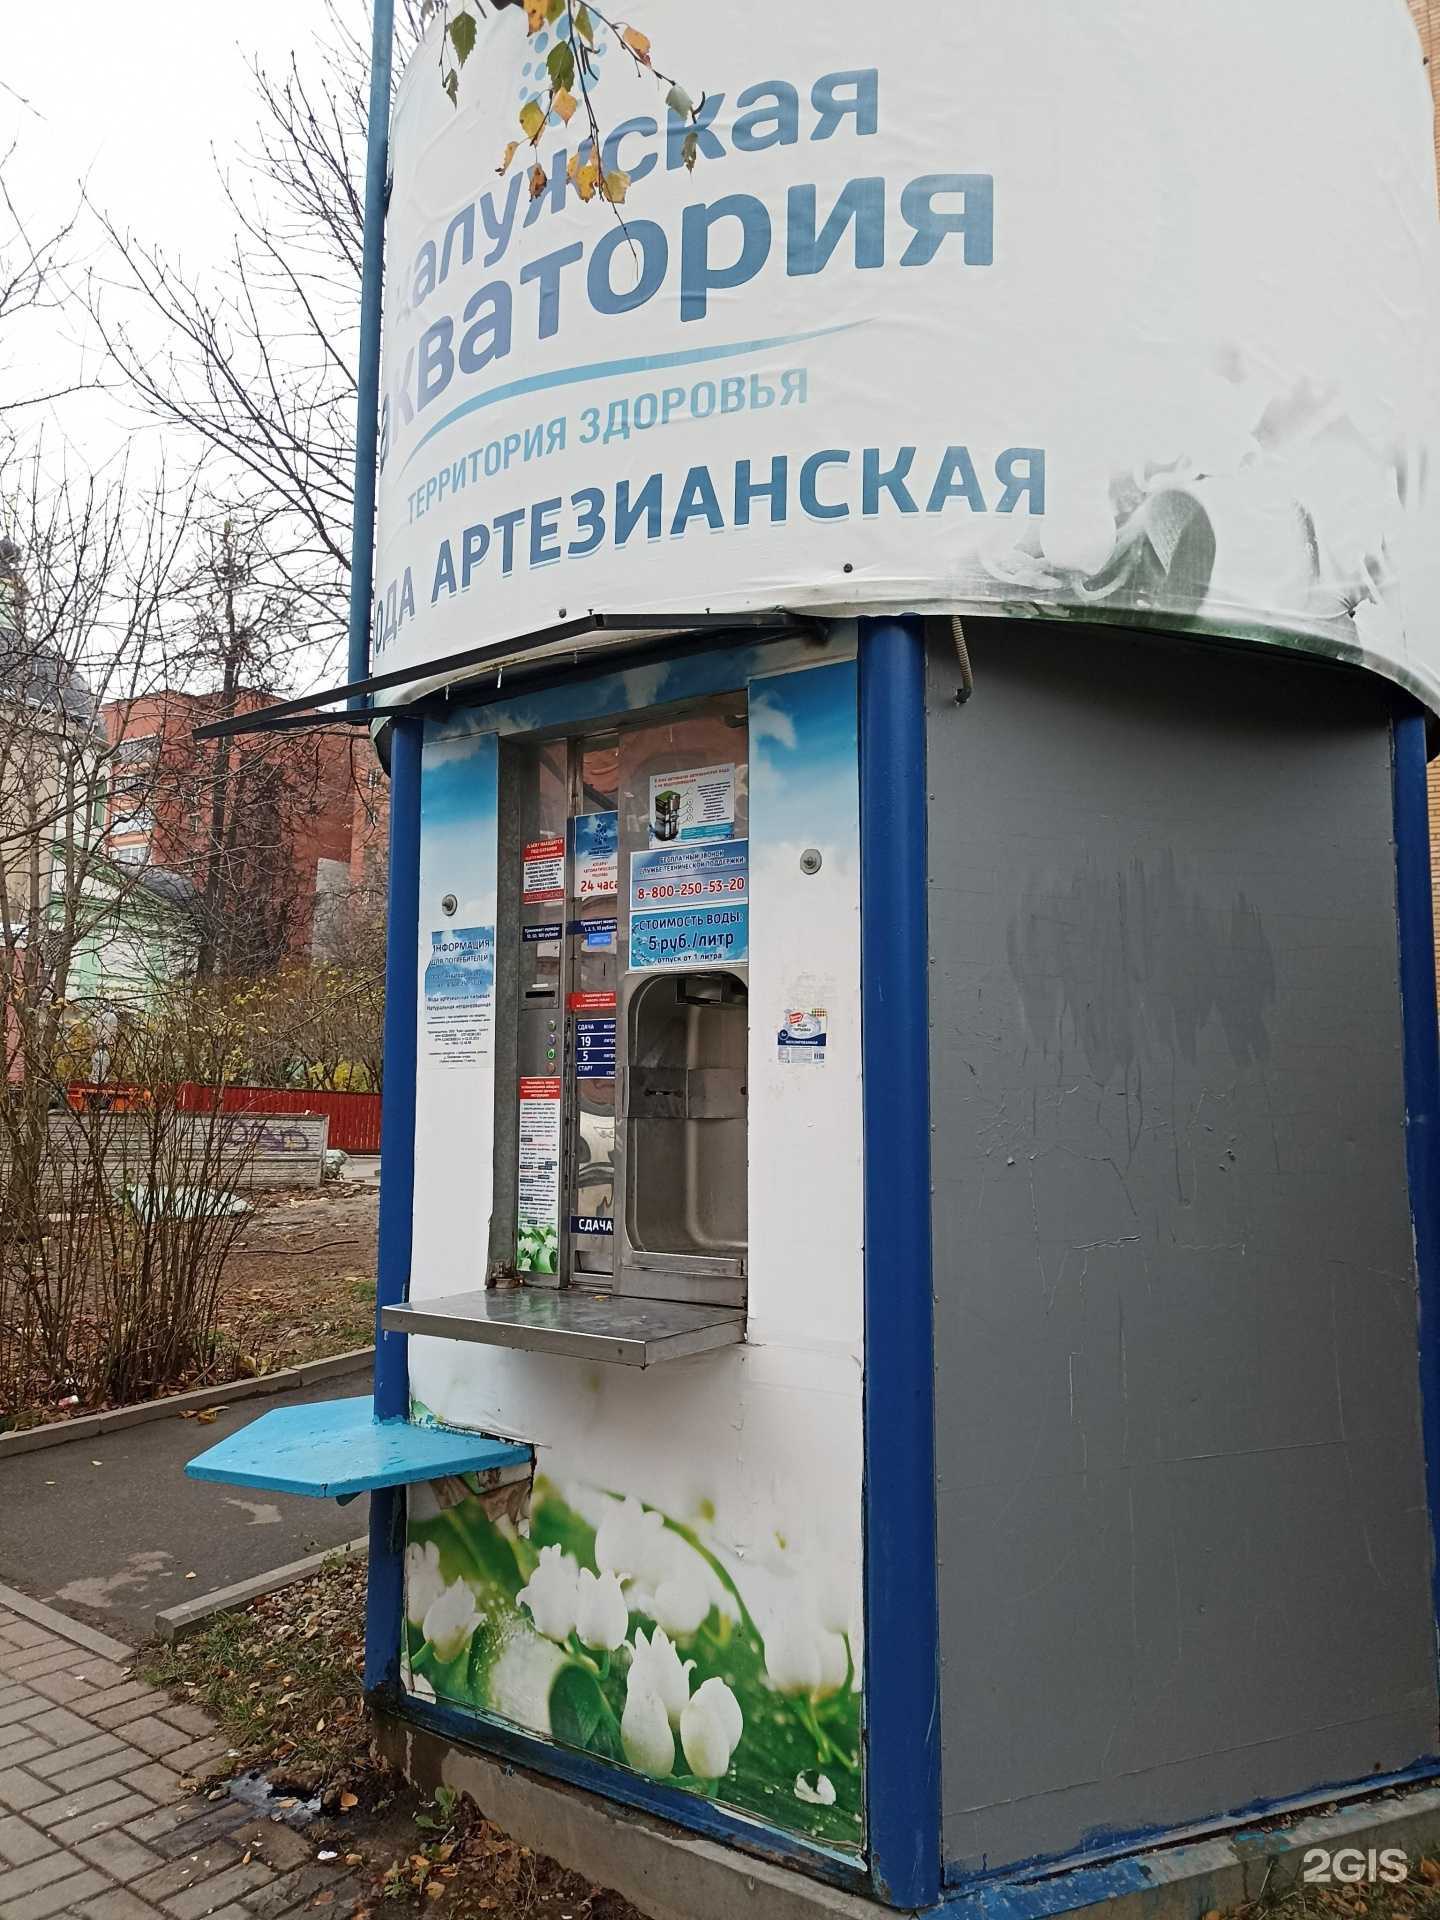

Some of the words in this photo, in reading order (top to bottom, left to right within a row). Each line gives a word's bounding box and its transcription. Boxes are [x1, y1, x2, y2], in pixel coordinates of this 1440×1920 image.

[408, 416, 567, 525] ТЕРРИТОРИЯ
[578, 367, 808, 446] ЗДОРОВЬЯ
[374, 566, 415, 655] ОДА
[431, 445, 1047, 606] АРТЕЗИАНСКАЯ
[581, 880, 594, 893] 24
[638, 877, 745, 900] 8-800-250-53-20
[639, 915, 704, 931] СТОИМОСТЬ
[649, 935, 657, 951] 5
[445, 953, 489, 964] ПОТРЕБИТЕЛЕЙ
[657, 956, 682, 964] отпуск
[577, 1023, 594, 1031] СДАЧА
[580, 1035, 592, 1047] 19
[582, 1050, 589, 1062] 5
[578, 1218, 613, 1232] СДАЧА
